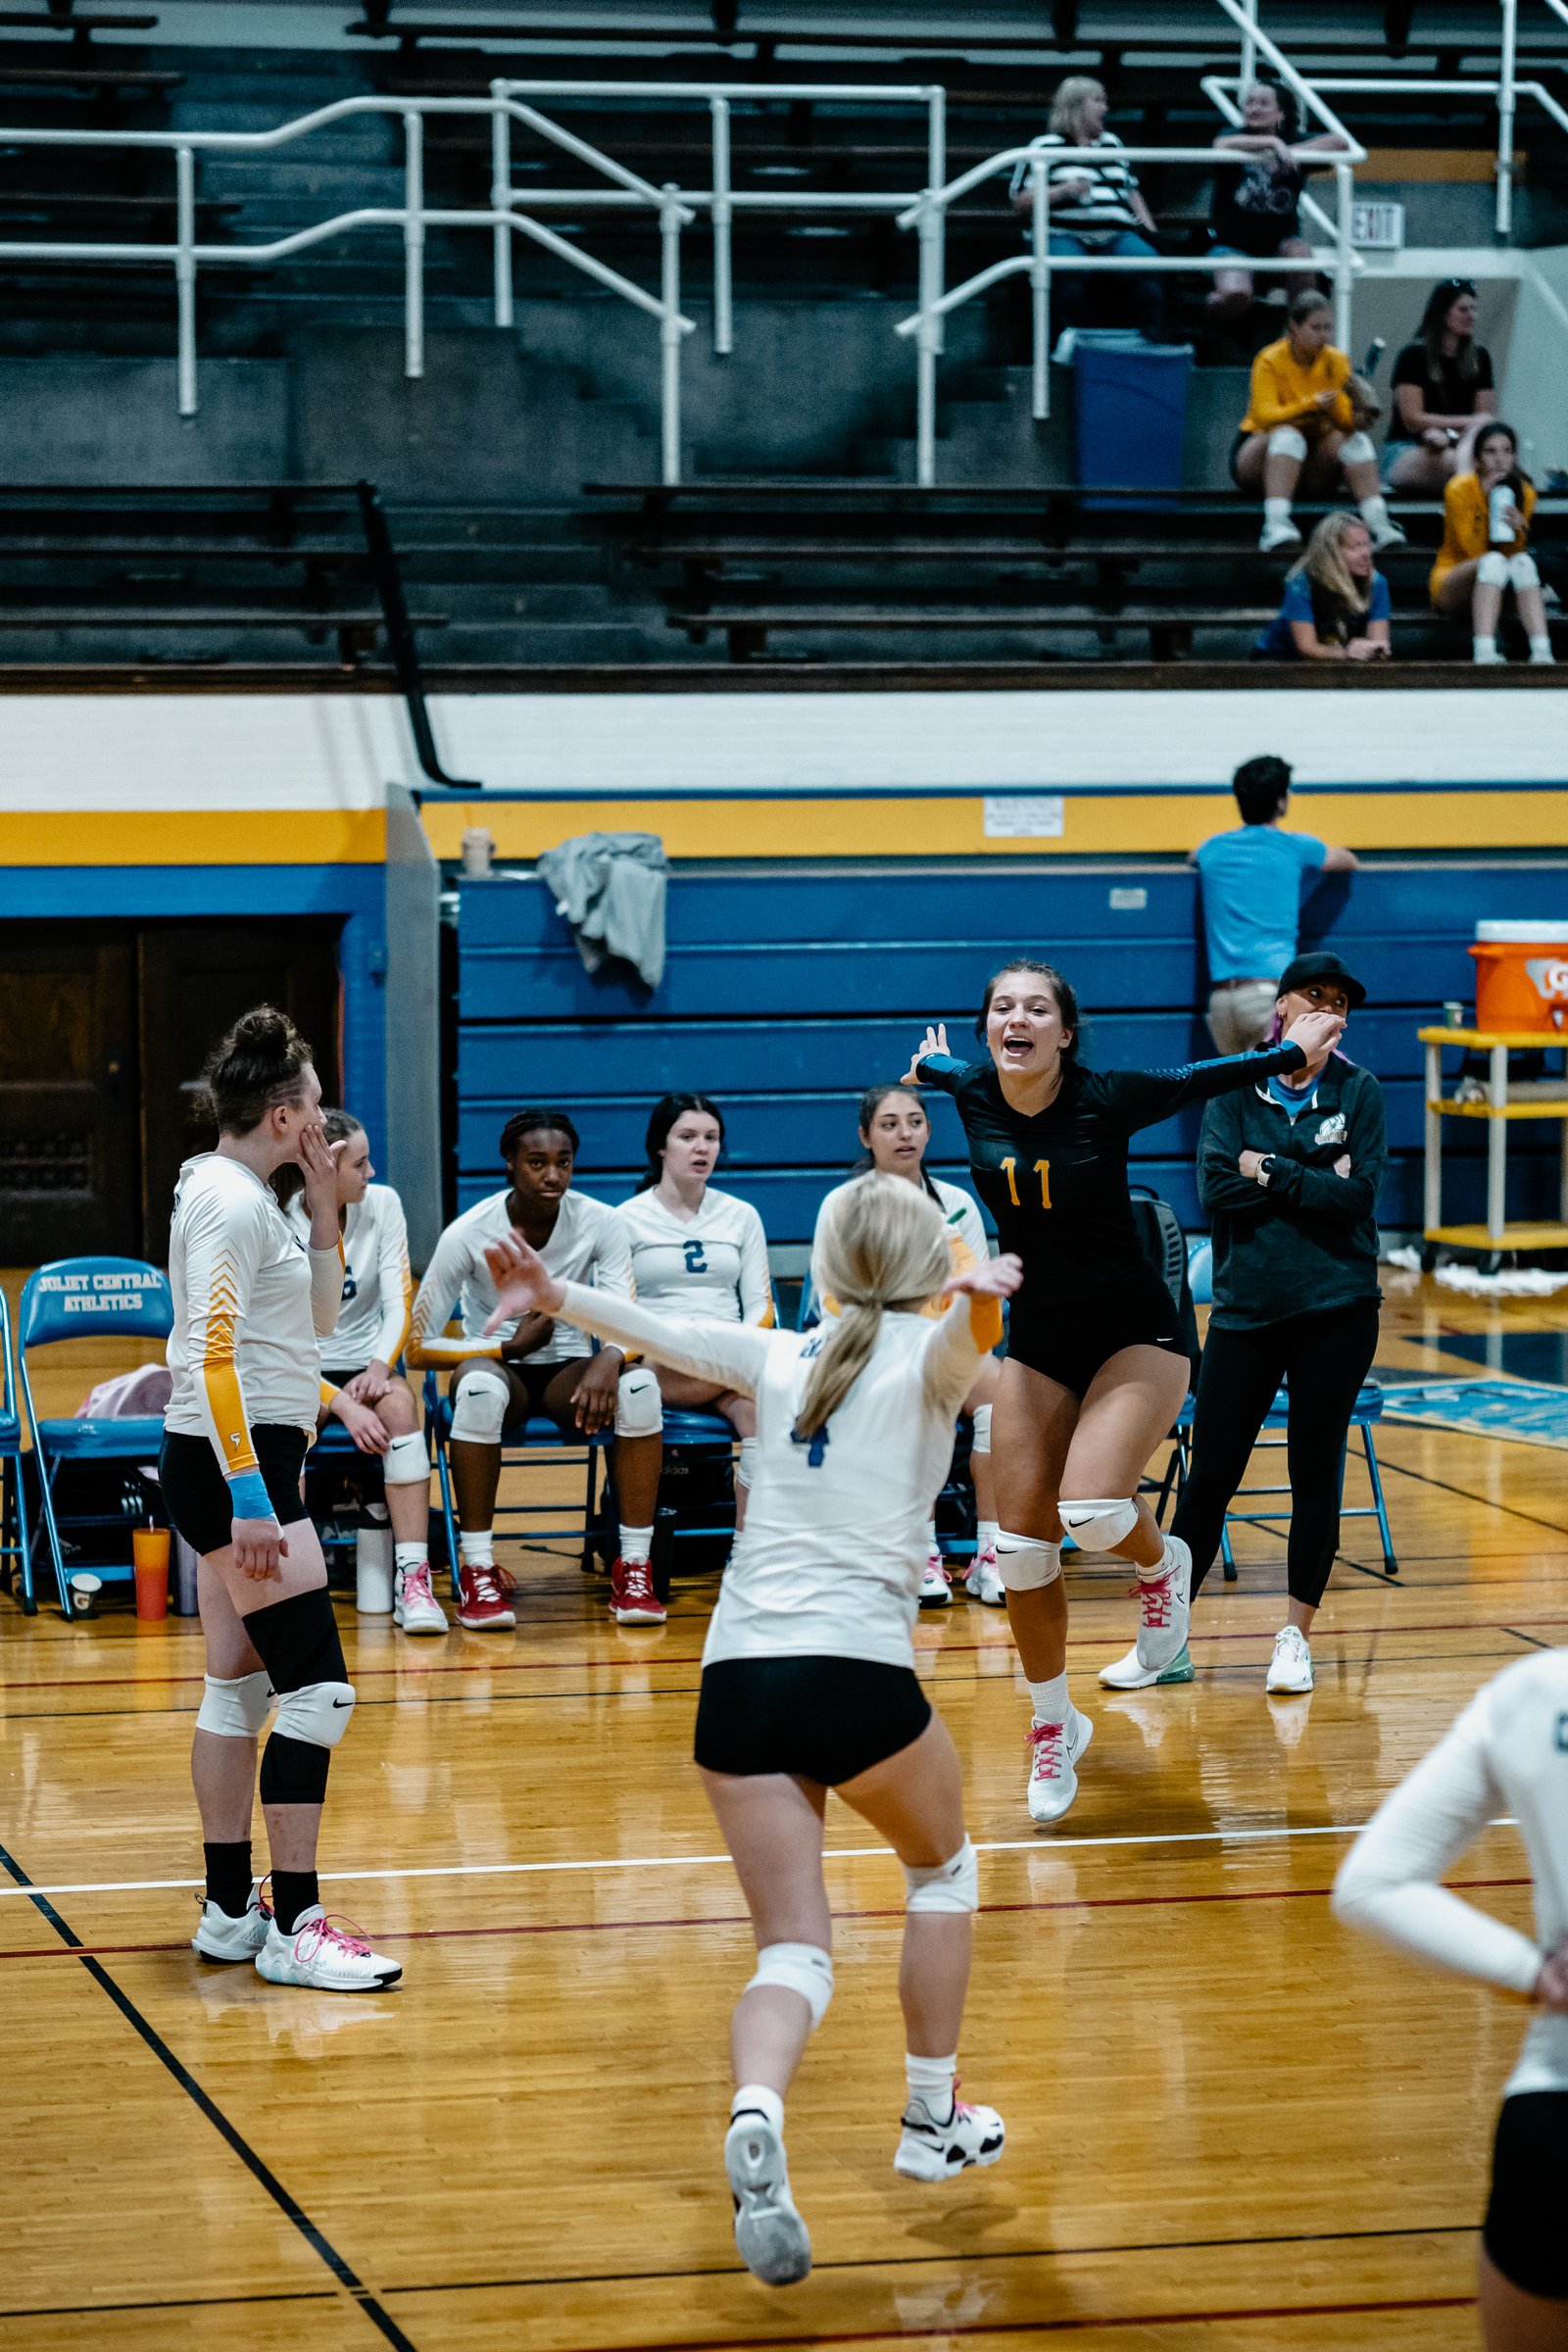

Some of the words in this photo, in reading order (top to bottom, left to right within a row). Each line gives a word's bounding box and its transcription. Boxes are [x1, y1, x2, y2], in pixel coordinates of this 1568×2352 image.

[1000, 1156, 1053, 1209] 11
[683, 1240, 708, 1273] 2
[39, 1275, 89, 1293] JOLIET
[92, 1273, 162, 1291] CENTRAL
[64, 1293, 143, 1312] ATHLETICS
[662, 1464, 690, 1475] didas
